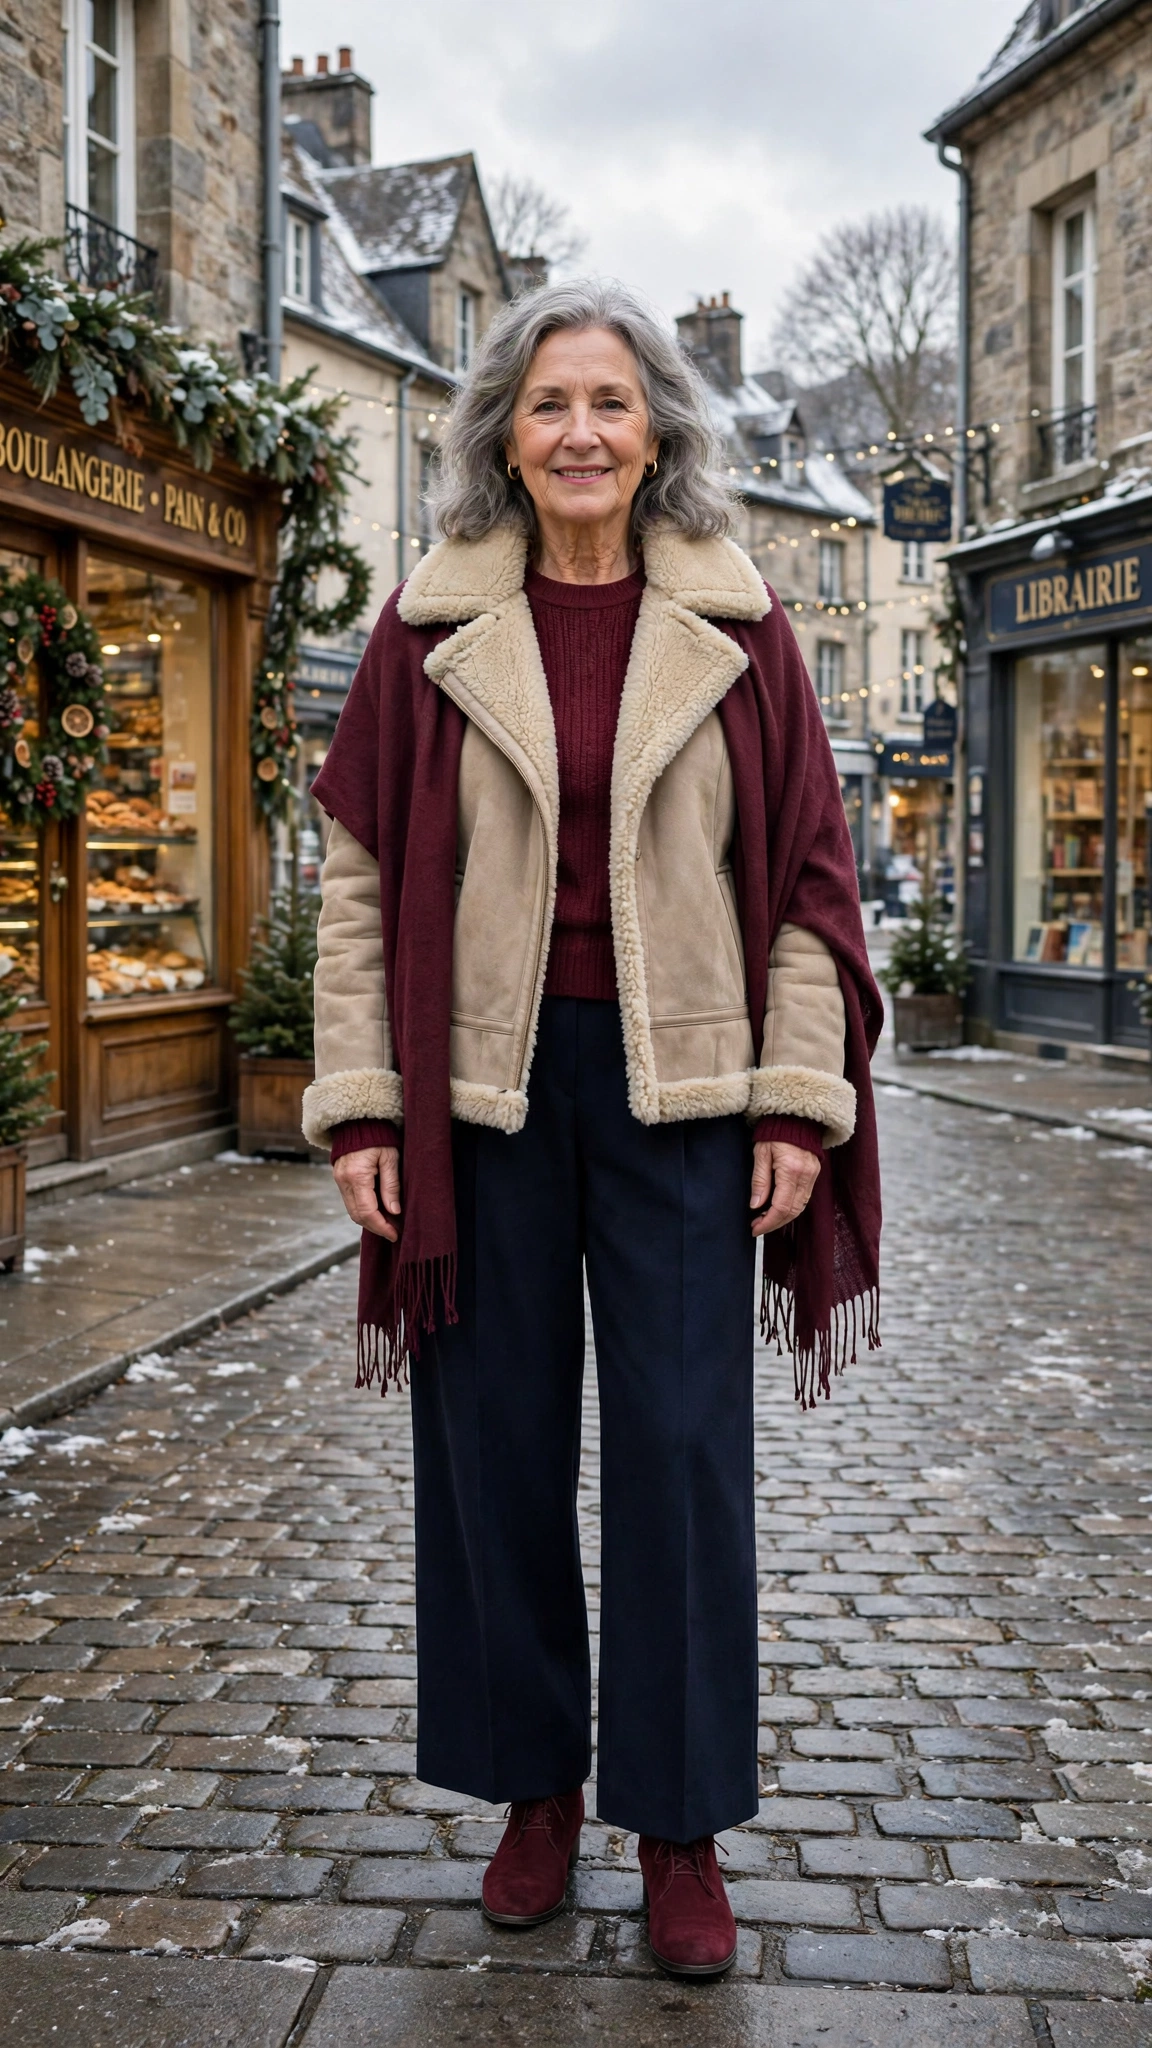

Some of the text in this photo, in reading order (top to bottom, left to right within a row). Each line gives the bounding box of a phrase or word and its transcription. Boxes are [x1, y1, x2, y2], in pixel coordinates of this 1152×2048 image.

[164, 483, 204, 532] PAIN
[208, 502, 220, 538] &
[224, 506, 247, 547] CO
[1015, 556, 1142, 624] LIBRAIRIE
